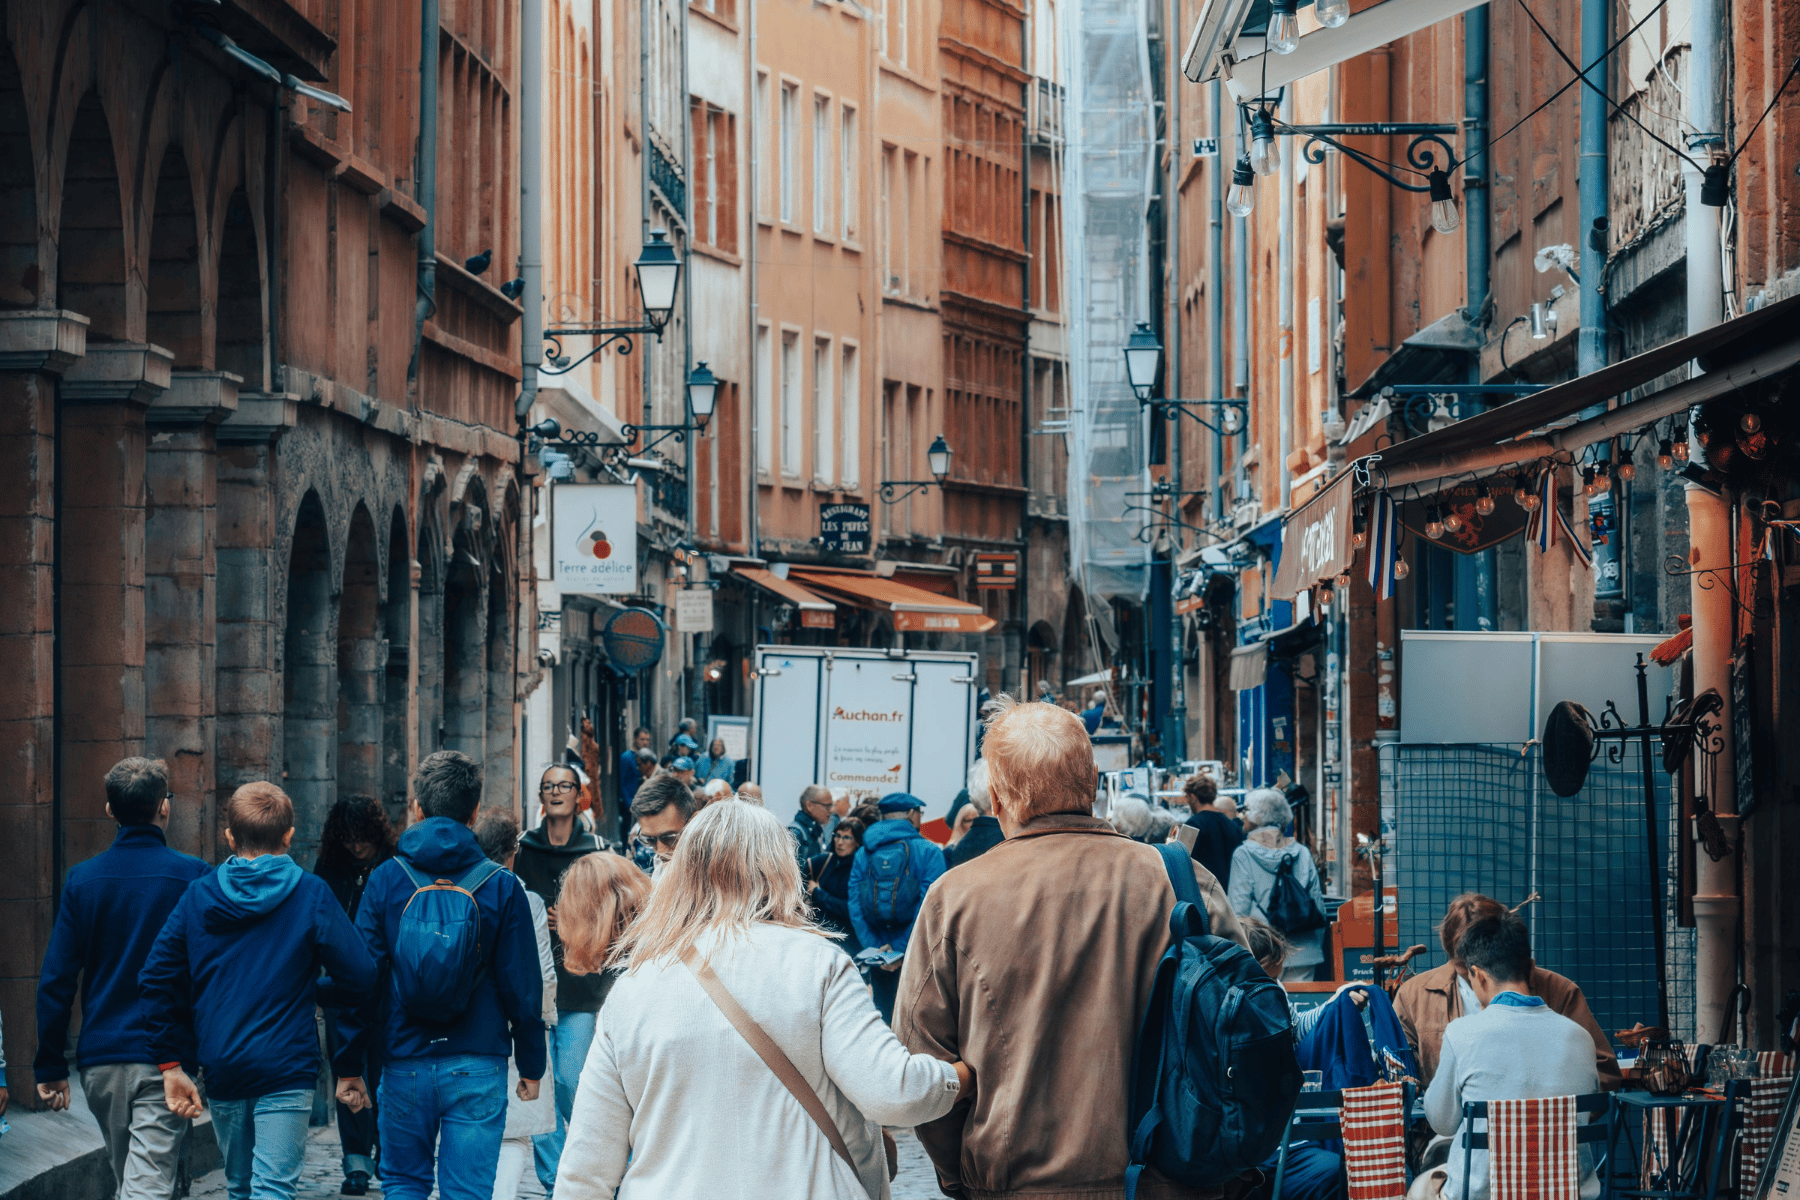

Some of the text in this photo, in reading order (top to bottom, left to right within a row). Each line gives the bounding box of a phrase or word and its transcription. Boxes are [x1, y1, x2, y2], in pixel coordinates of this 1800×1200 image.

[821, 521, 839, 532] LES
[840, 540, 864, 552] JEAN
[558, 560, 633, 574] Terre adélice
[832, 706, 904, 722] Auchan.fr
[829, 771, 899, 784] Commandez
